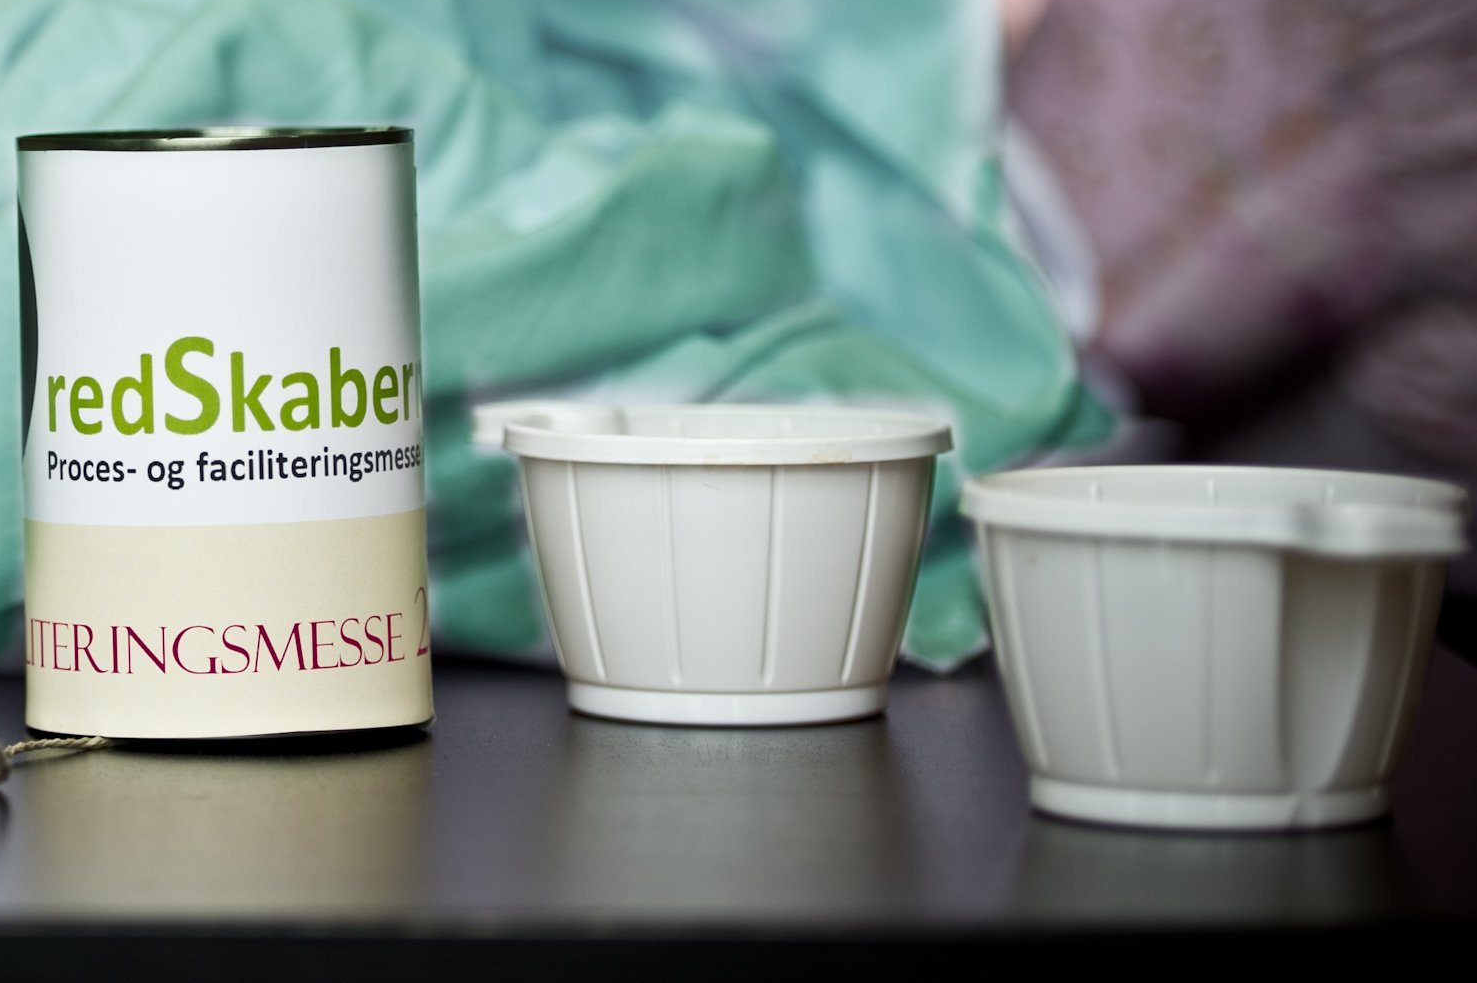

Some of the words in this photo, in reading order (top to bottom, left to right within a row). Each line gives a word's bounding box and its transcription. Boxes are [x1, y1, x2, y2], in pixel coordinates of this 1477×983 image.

[47, 450, 137, 482] Proces-
[147, 460, 185, 490] og
[25, 611, 406, 675] ITERINGSMESSE
